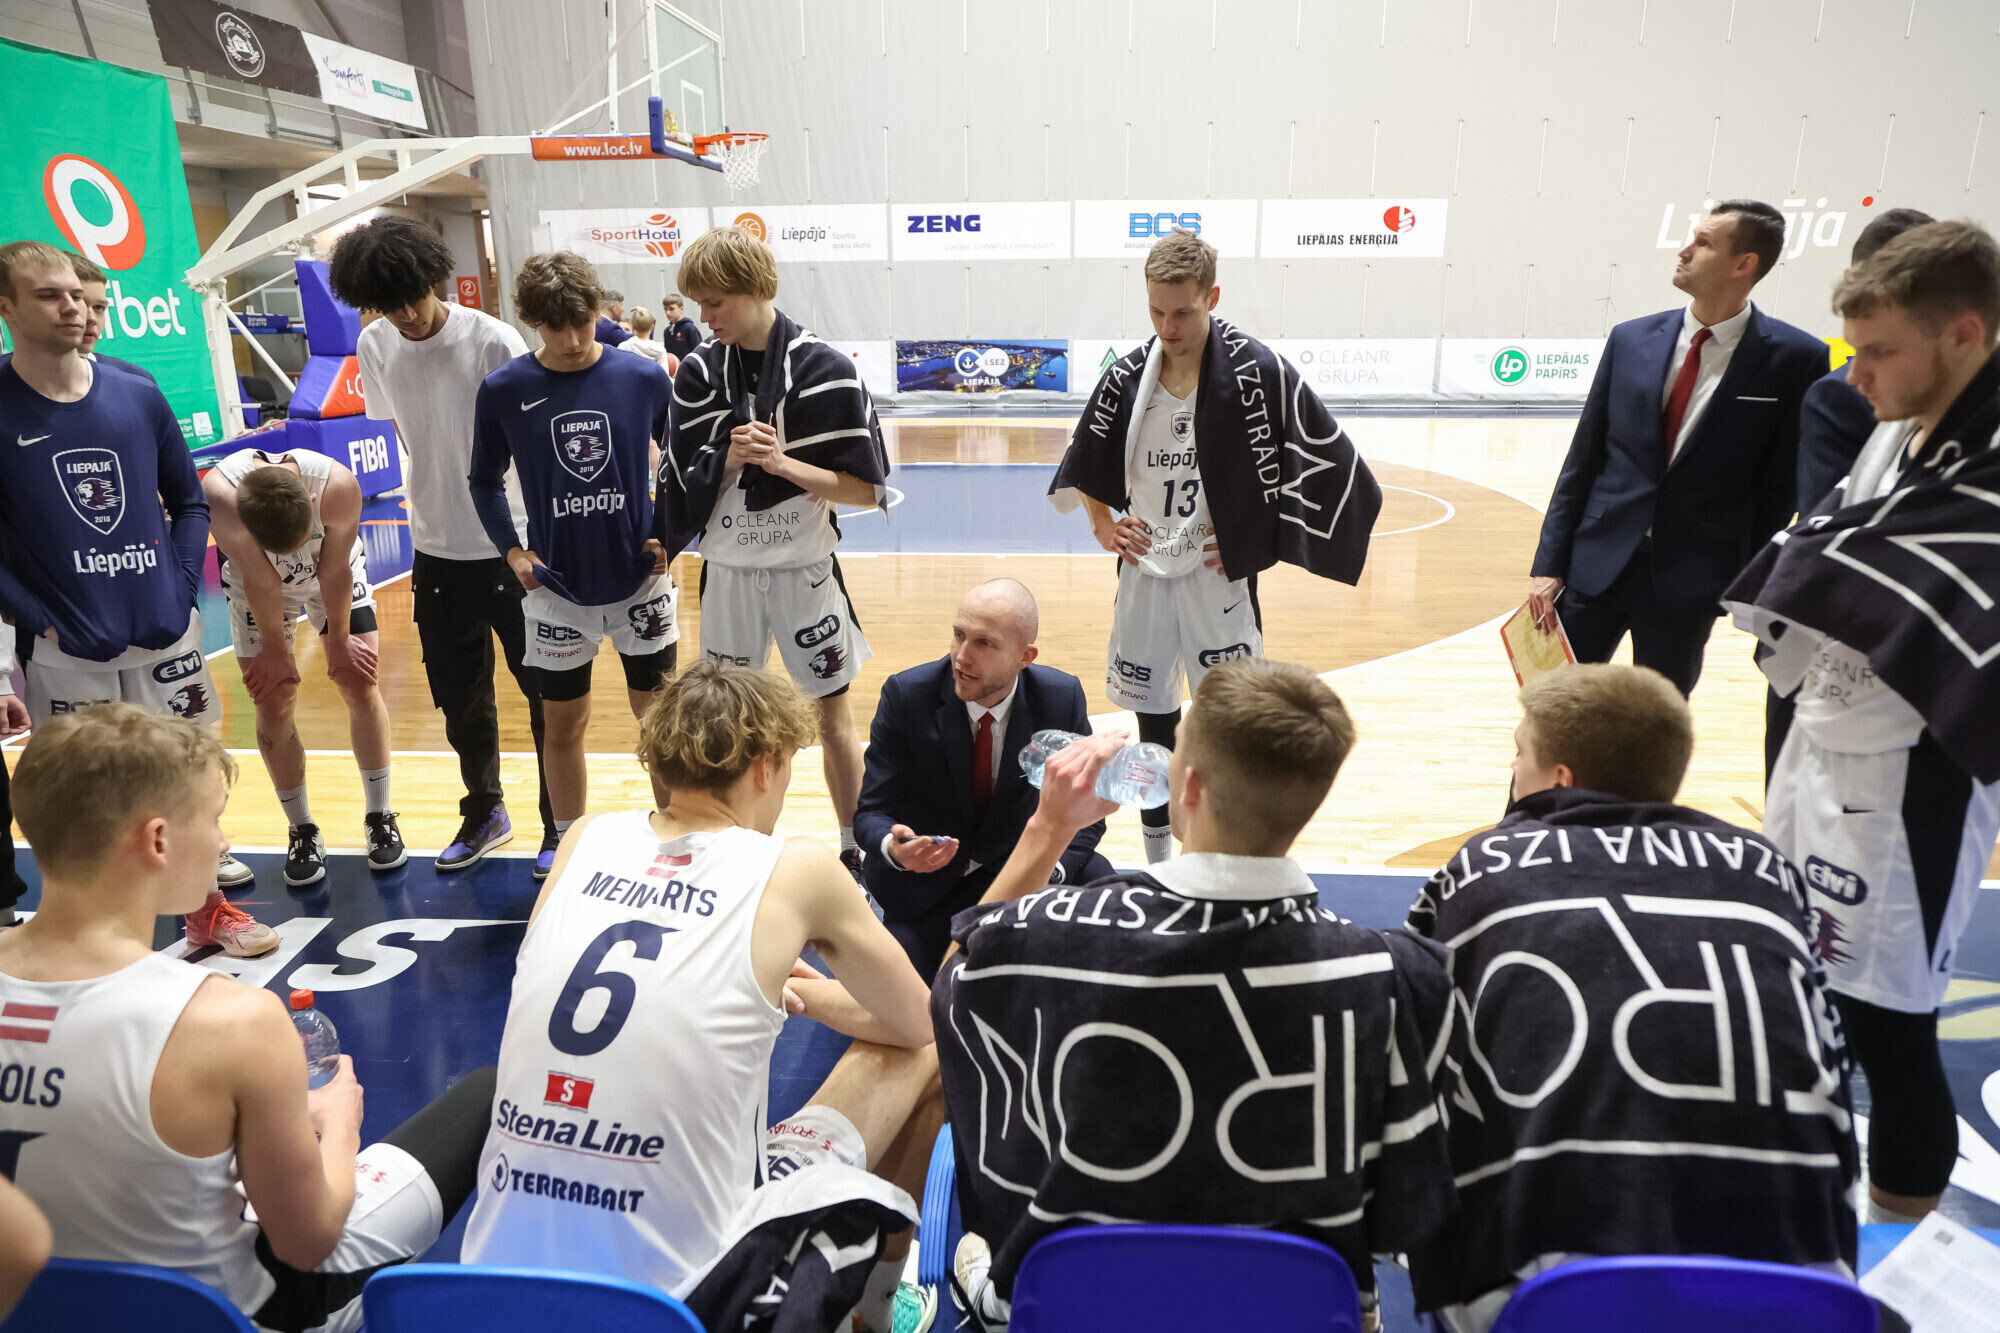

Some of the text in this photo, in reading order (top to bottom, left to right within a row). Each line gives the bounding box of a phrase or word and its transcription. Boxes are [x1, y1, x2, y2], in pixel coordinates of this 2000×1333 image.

[564, 142, 643, 156] www.loc.lv
[907, 215, 981, 233] ZENG
[1129, 213, 1202, 237] BCS
[591, 229, 681, 243] SportHotel
[781, 227, 826, 242] Liepāja
[1297, 233, 1399, 248] LIEPĀJAS ENERĢIJA
[98, 280, 187, 338] fbet
[1319, 350, 1390, 365] CLEANR
[1536, 352, 1590, 365] LIEPĀJAS
[1318, 368, 1380, 385] GRUPA
[1535, 368, 1578, 379] PAPĪRS
[348, 435, 389, 476] FIBA
[580, 465, 594, 473] 2018
[552, 487, 626, 518] Liepāja
[1163, 479, 1202, 518] 13
[736, 511, 800, 529] CLEANR
[737, 529, 793, 545] GRUPA
[73, 543, 157, 577] Liepāja
[537, 621, 583, 640] BCS
[547, 919, 682, 1057] 6
[0, 1063, 66, 1108] OLS
[560, 1079, 576, 1103] S
[497, 1098, 665, 1158] Stena Line
[511, 1168, 645, 1213] TERRABALT
